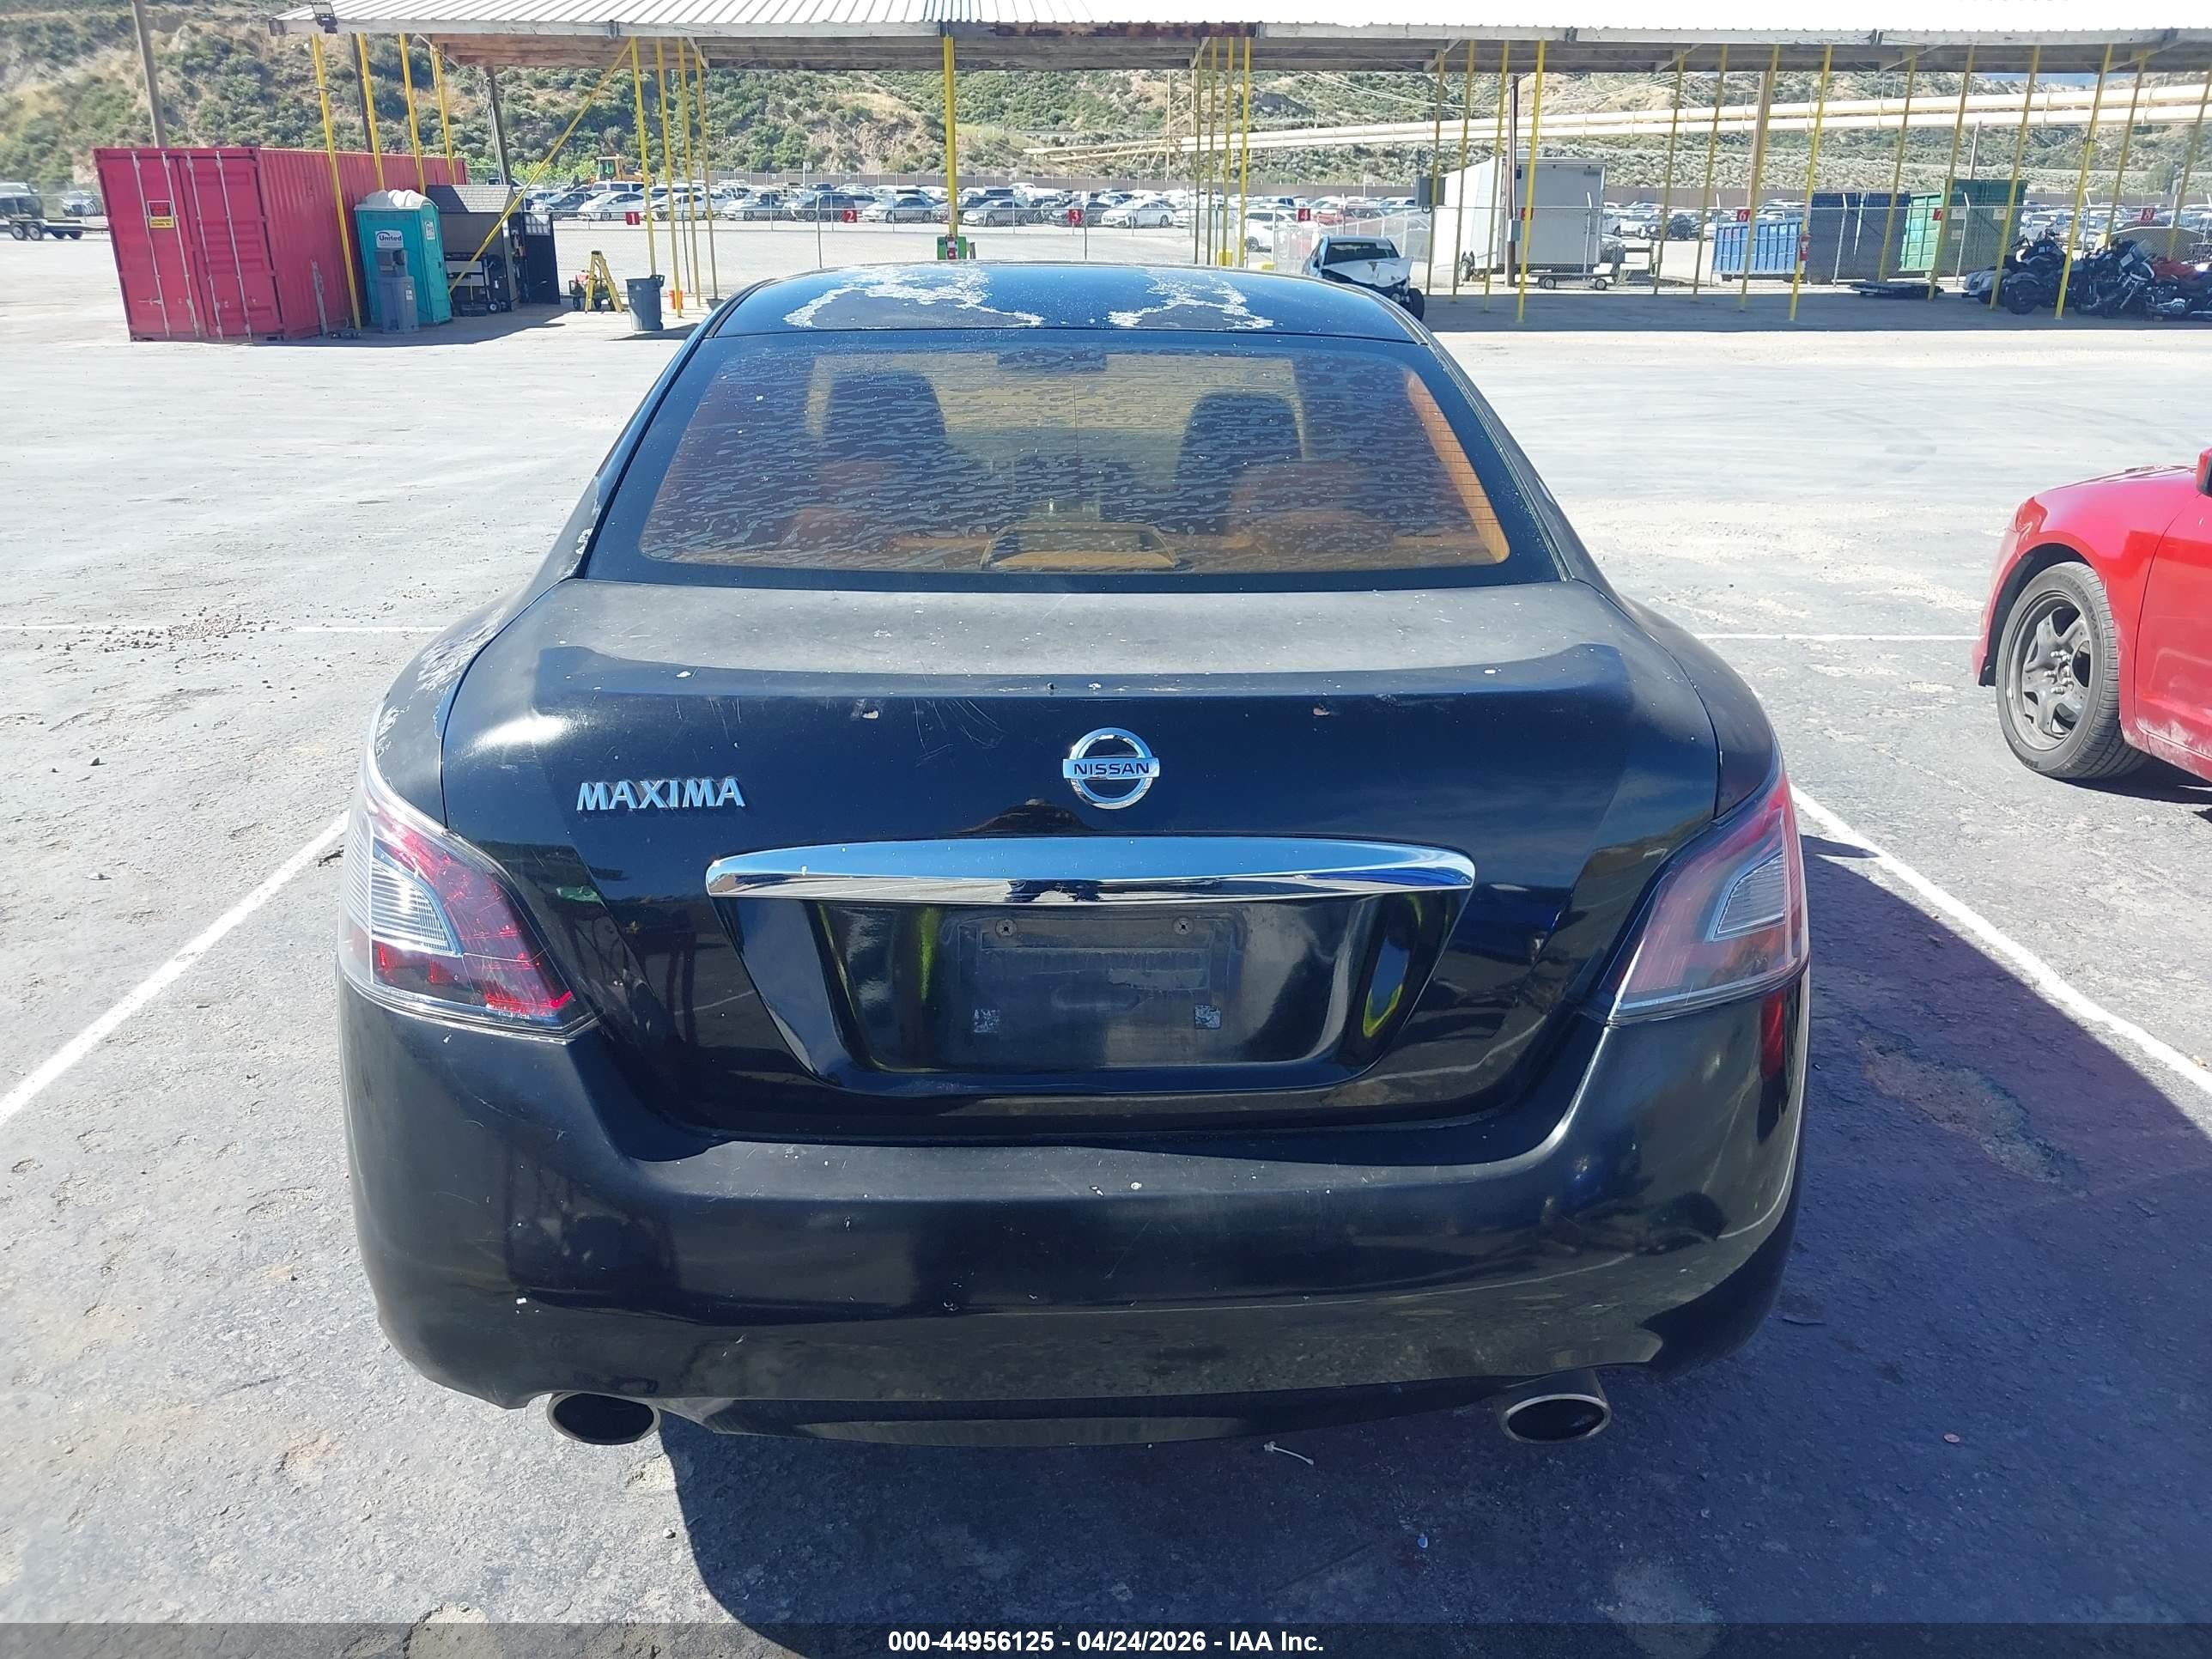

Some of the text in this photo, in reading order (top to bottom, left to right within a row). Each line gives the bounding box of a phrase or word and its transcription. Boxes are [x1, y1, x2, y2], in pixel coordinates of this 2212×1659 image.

[847, 210, 854, 222] 2
[1072, 210, 1079, 222] 3
[1300, 210, 1308, 220] 4
[1739, 210, 1747, 221] 6
[2144, 208, 2152, 219] 8
[1073, 762, 1150, 775] NISSAN
[576, 777, 745, 811] MAXIMA
